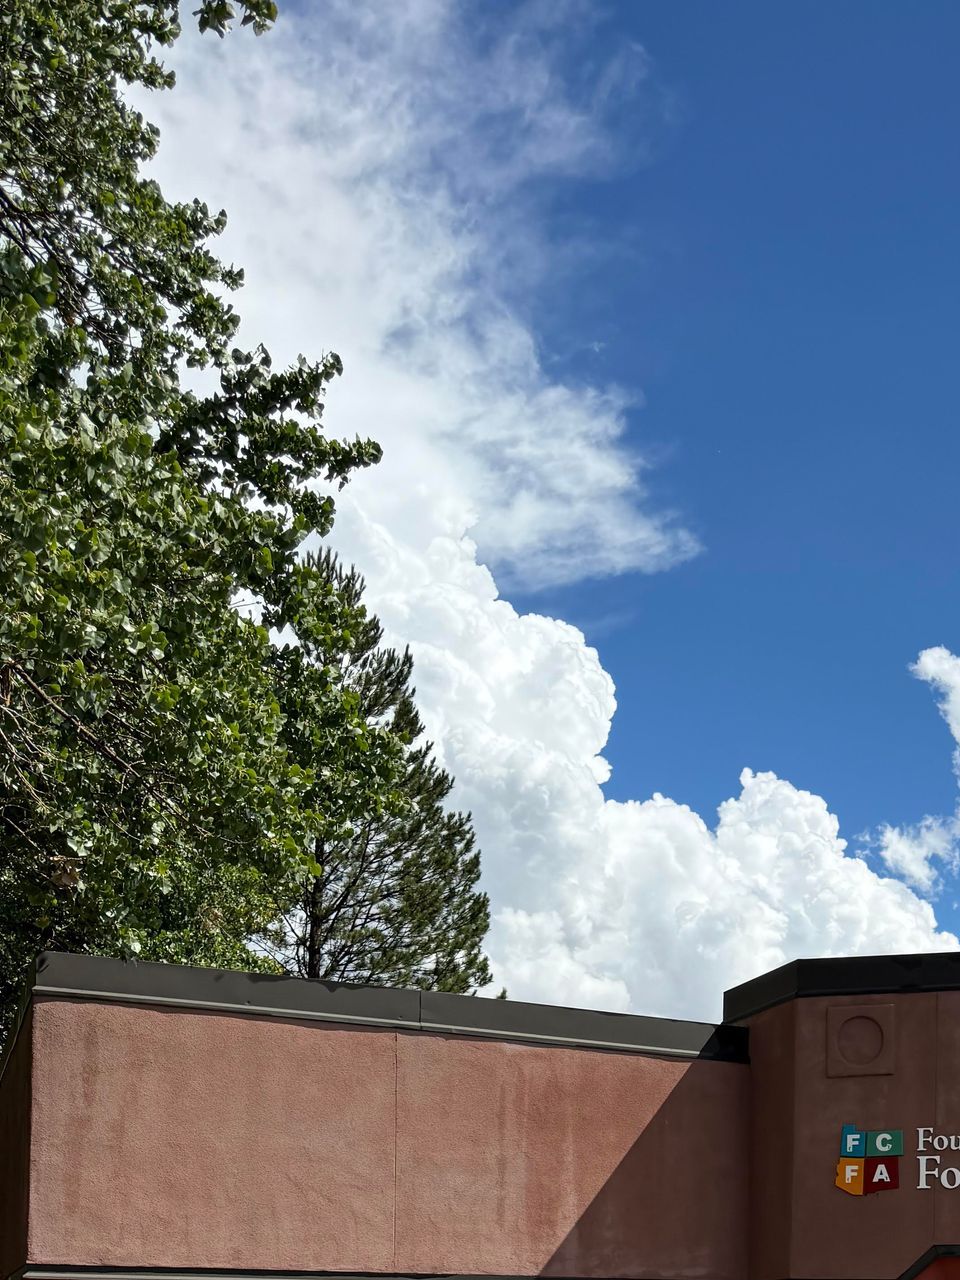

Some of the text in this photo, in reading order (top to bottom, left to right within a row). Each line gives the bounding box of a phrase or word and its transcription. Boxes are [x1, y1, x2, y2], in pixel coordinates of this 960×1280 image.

[846, 1133, 893, 1153] F C
[845, 1164, 891, 1184] F A
